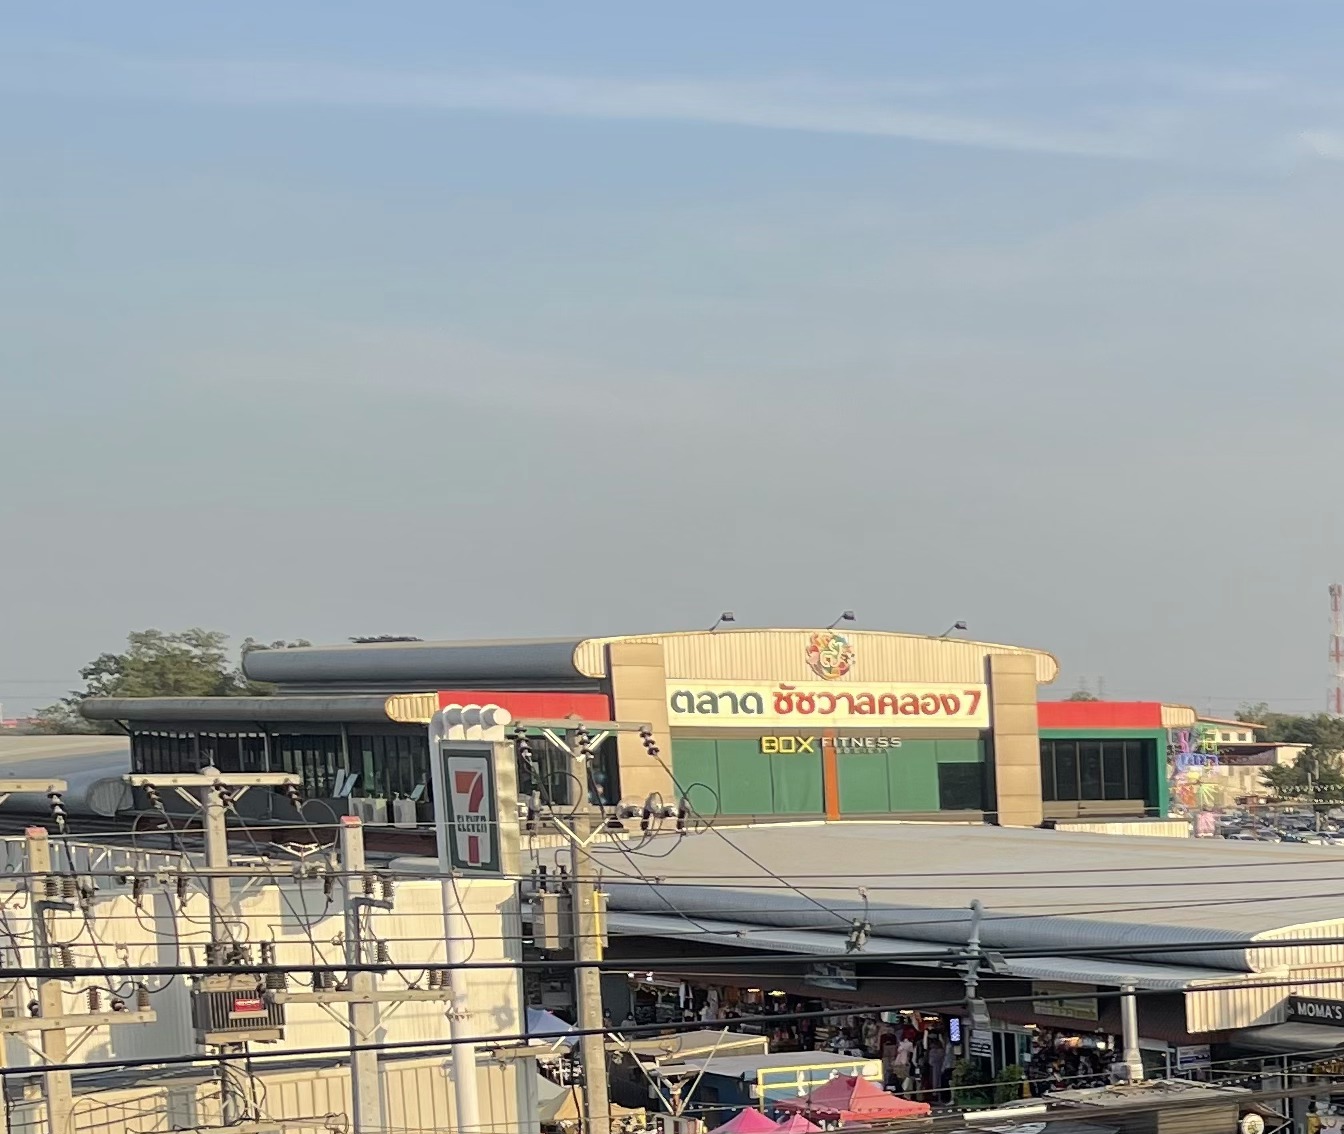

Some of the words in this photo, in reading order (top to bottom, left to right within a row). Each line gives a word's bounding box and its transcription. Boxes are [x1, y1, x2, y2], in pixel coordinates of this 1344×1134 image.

[669, 689, 764, 715] ตลาด
[761, 736, 815, 753] BOX
[821, 736, 902, 748] FITNESS
[1297, 1001, 1343, 1021] MOMA'S
